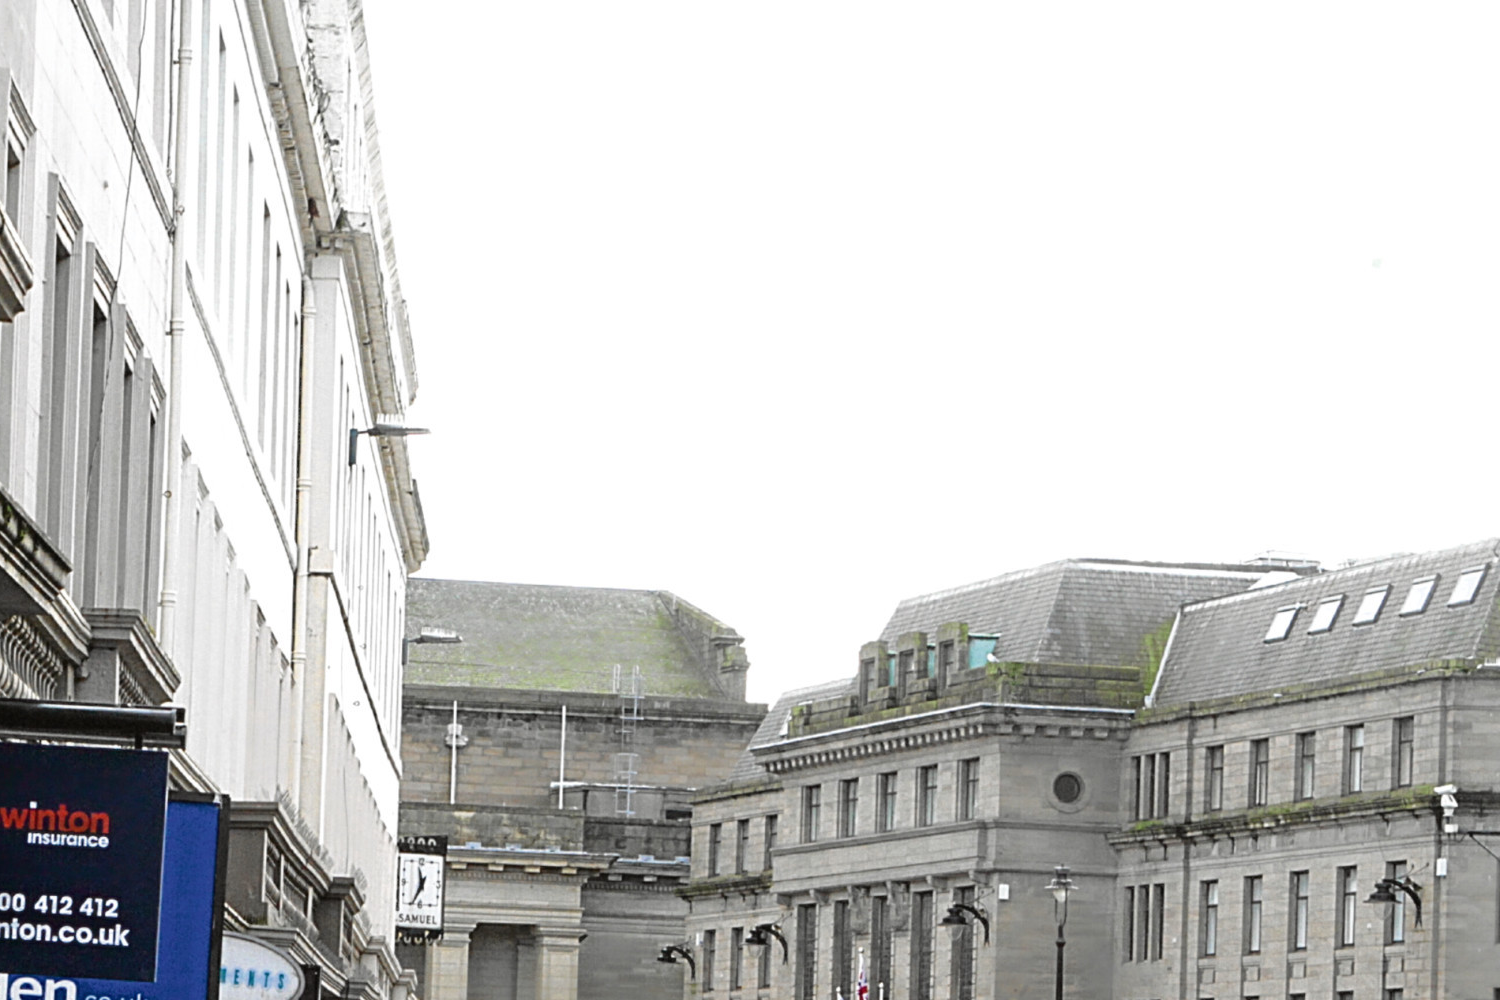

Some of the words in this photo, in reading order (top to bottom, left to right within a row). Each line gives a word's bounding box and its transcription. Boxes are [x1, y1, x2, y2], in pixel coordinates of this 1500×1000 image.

[27, 832, 109, 848] insurance
[34, 895, 73, 915] 412
[79, 898, 119, 918] 412
[398, 913, 438, 925] SAMUEL
